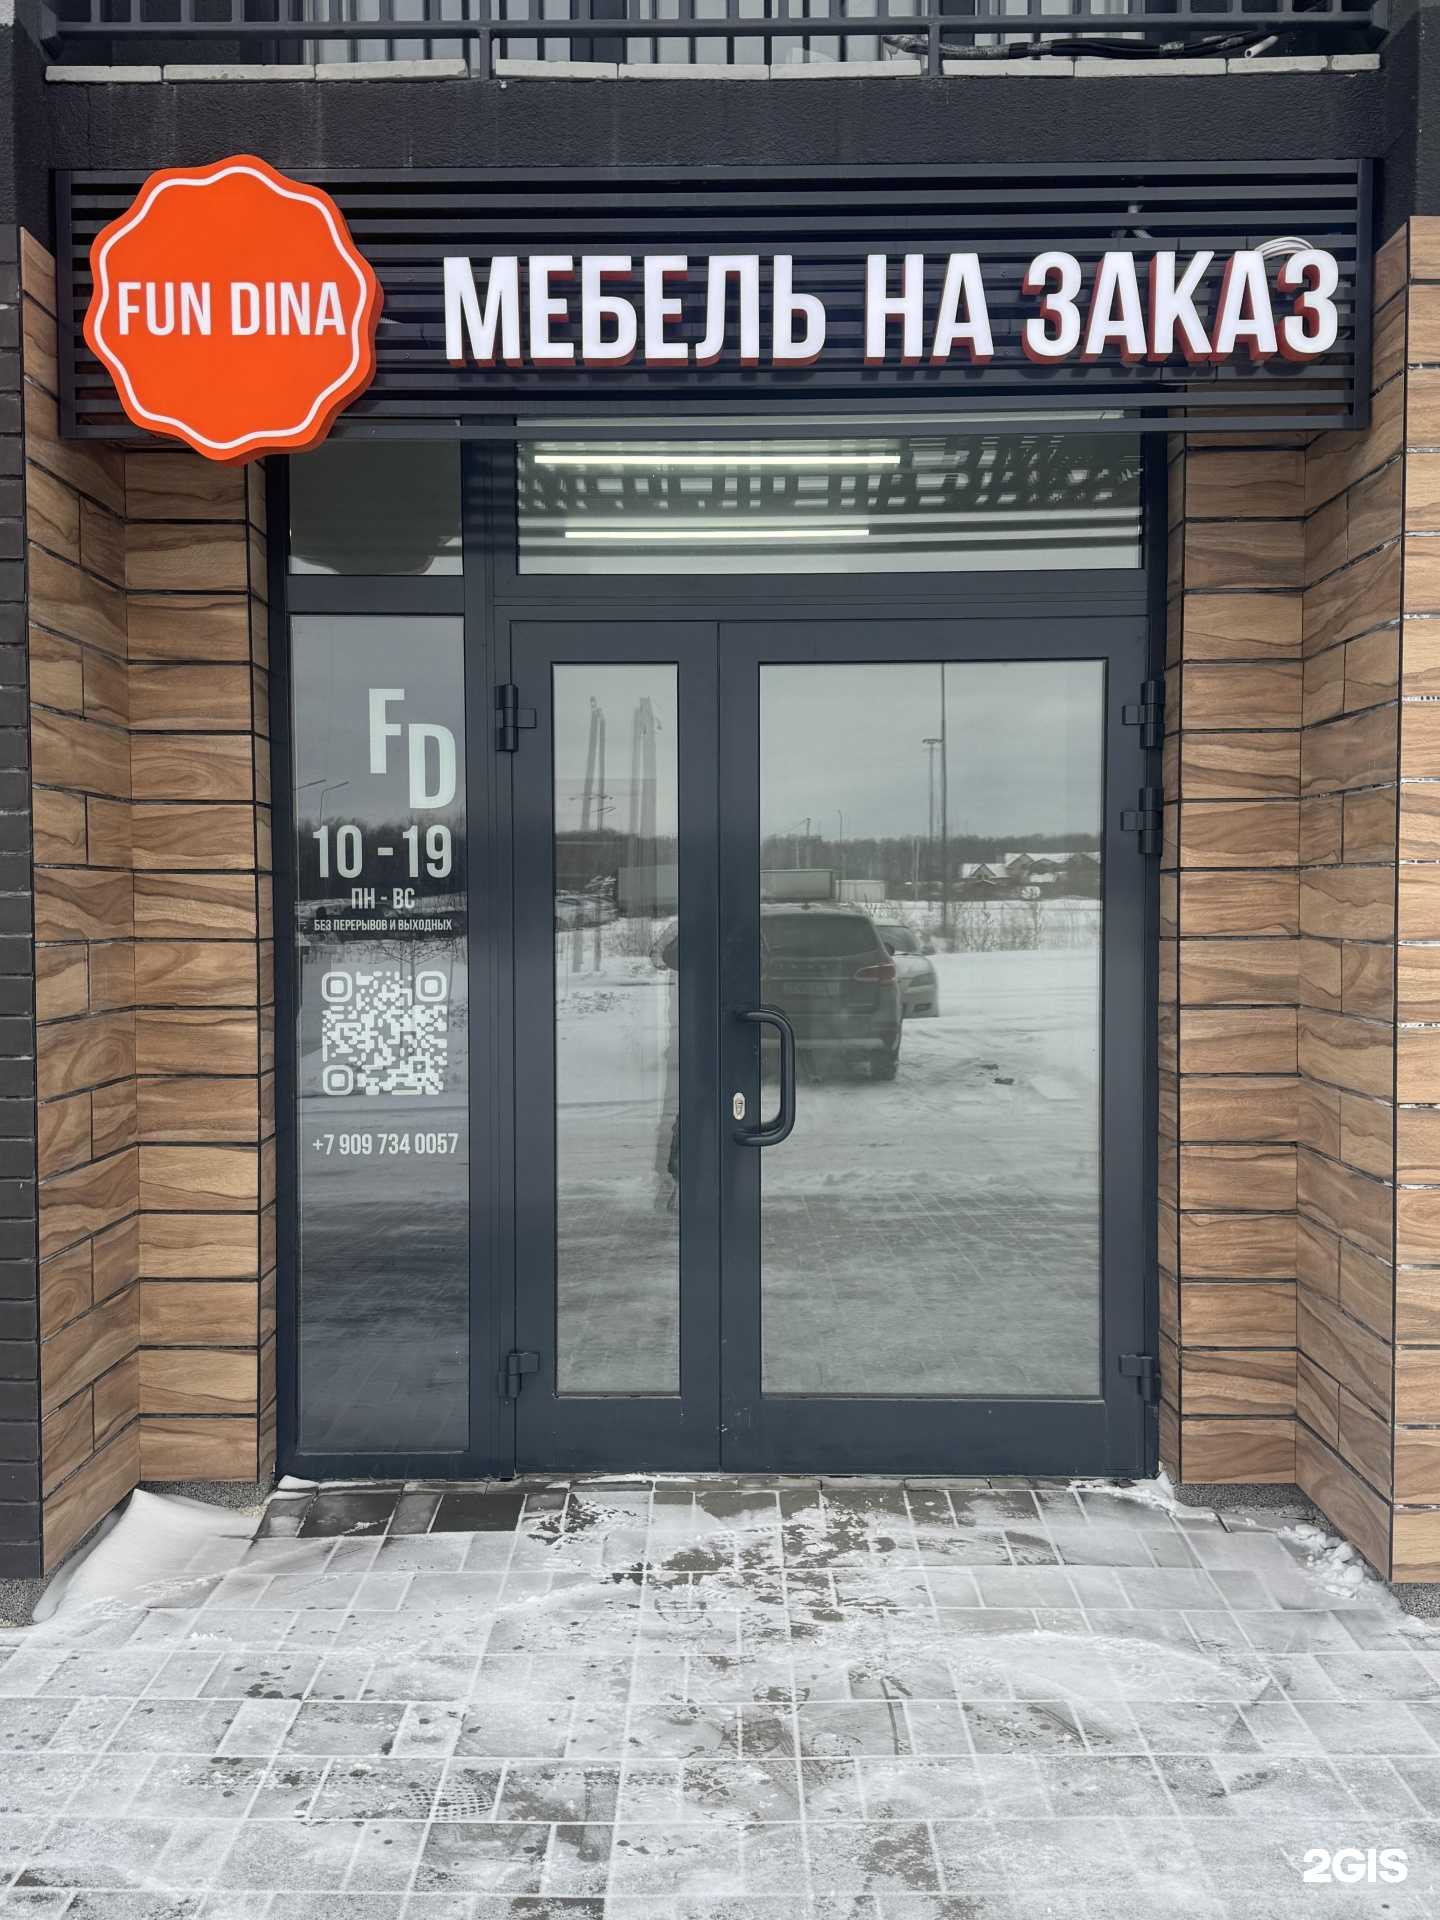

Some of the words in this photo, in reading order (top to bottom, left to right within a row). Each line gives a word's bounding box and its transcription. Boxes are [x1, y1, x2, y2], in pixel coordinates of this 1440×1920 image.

[117, 281, 212, 336] FUN
[231, 281, 346, 336] DINA
[443, 254, 827, 363] МЕБЕЛЬ
[865, 252, 994, 361] НА
[1025, 250, 1339, 358] ЗАКАЗ
[351, 887, 376, 910] ПН
[392, 887, 416, 910] ВС
[314, 919, 332, 932] БЕЗ
[333, 919, 388, 932] ПЕРЕРЫВОВ
[389, 919, 396, 931] И
[398, 919, 453, 932] ВЫХОДНЫХ
[312, 1133, 335, 1155] +7
[339, 1133, 373, 1155] 909
[377, 1133, 411, 1155] 734
[414, 1132, 459, 1155] 0057
